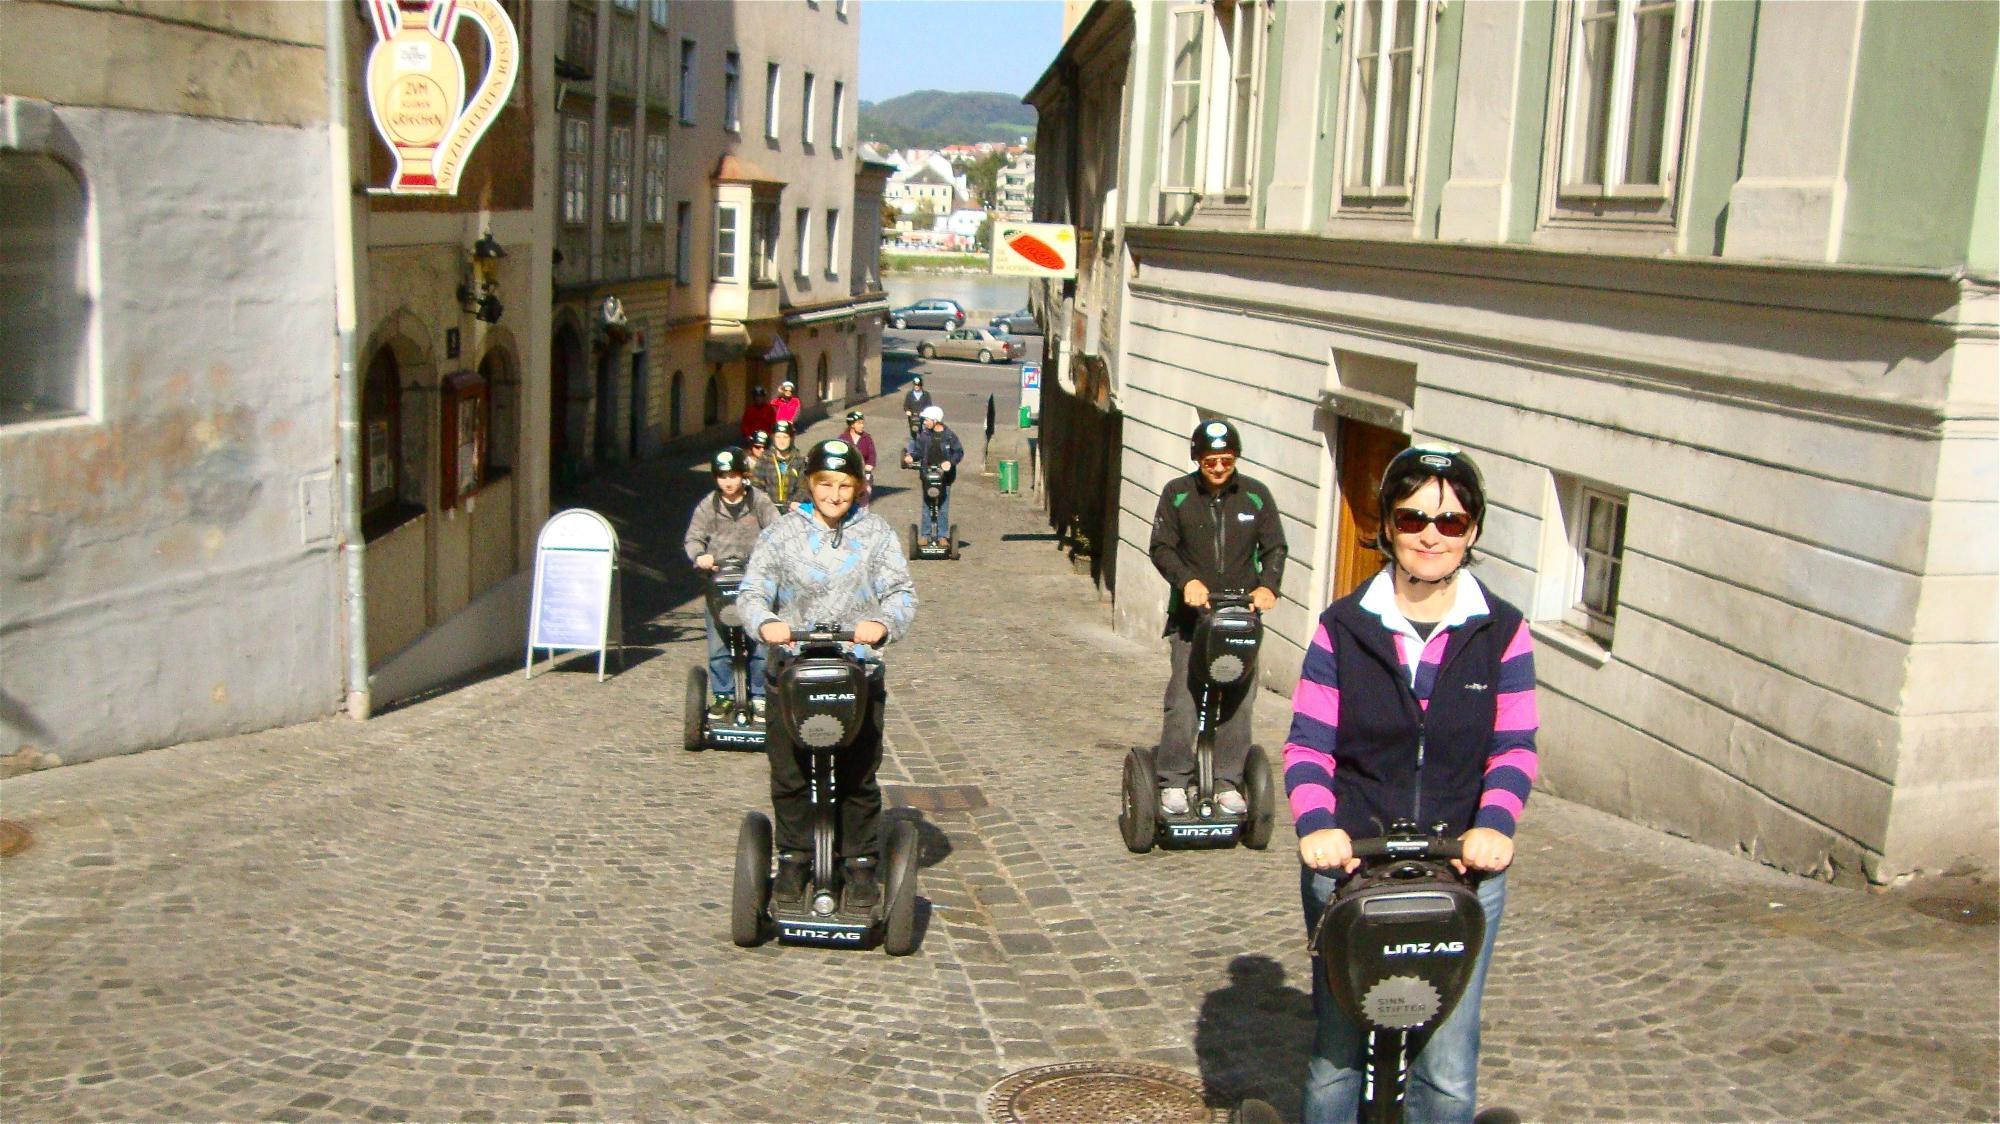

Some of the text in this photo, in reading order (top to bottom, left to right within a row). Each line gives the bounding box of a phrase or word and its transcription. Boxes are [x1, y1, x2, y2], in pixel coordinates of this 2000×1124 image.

[809, 693, 837, 701] LINZ
[1173, 827, 1233, 836] LINZ AG
[783, 928, 861, 940] LINZ AG
[1383, 941, 1465, 955] LINZ AG
[1377, 997, 1405, 1005] SINN
